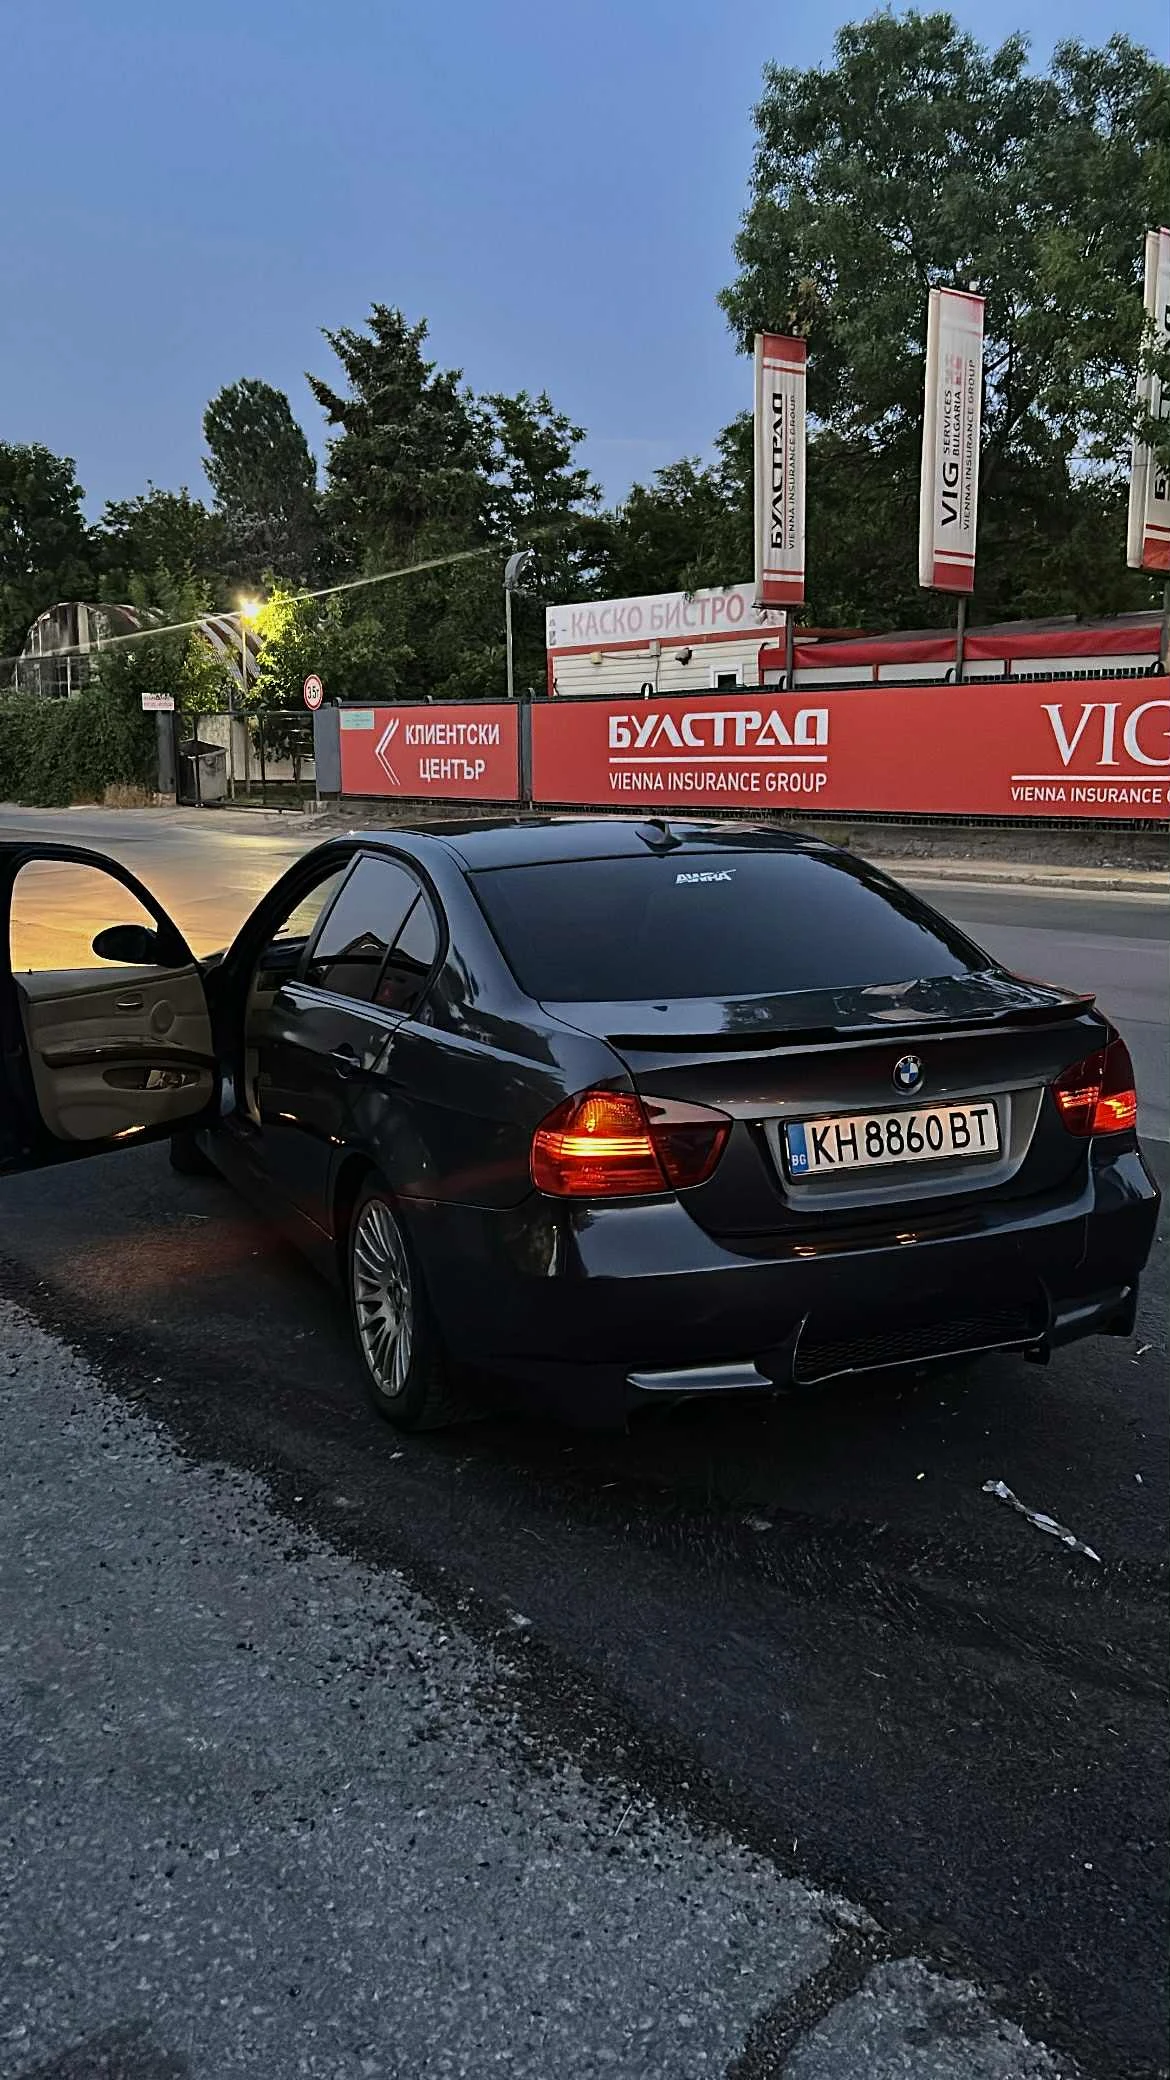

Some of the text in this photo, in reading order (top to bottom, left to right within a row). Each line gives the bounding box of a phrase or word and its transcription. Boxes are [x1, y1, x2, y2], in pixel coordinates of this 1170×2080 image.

[943, 389, 952, 455] SERVICES
[952, 391, 962, 456] BULGARIA
[963, 359, 976, 531] VIENNA INSURANCE GROUP
[771, 392, 783, 549] БУЛСТРАД
[788, 441, 796, 505] INSURANCE
[941, 461, 959, 527] VIG
[788, 507, 796, 550] VIENNA
[571, 606, 643, 639] КАСКО
[650, 593, 744, 630] БИСТРО
[405, 723, 500, 745] КЛИЕНТСКИ
[608, 708, 829, 749] БУЛСТРАД
[1040, 699, 1170, 768] VIG
[419, 758, 486, 783] ЦЕНТЪР
[609, 772, 828, 793] VIENNA INSURANCE GROUP
[1011, 786, 1066, 802] VIENNA
[1070, 787, 1162, 804] INSURANCE
[791, 1153, 807, 1166] BG
